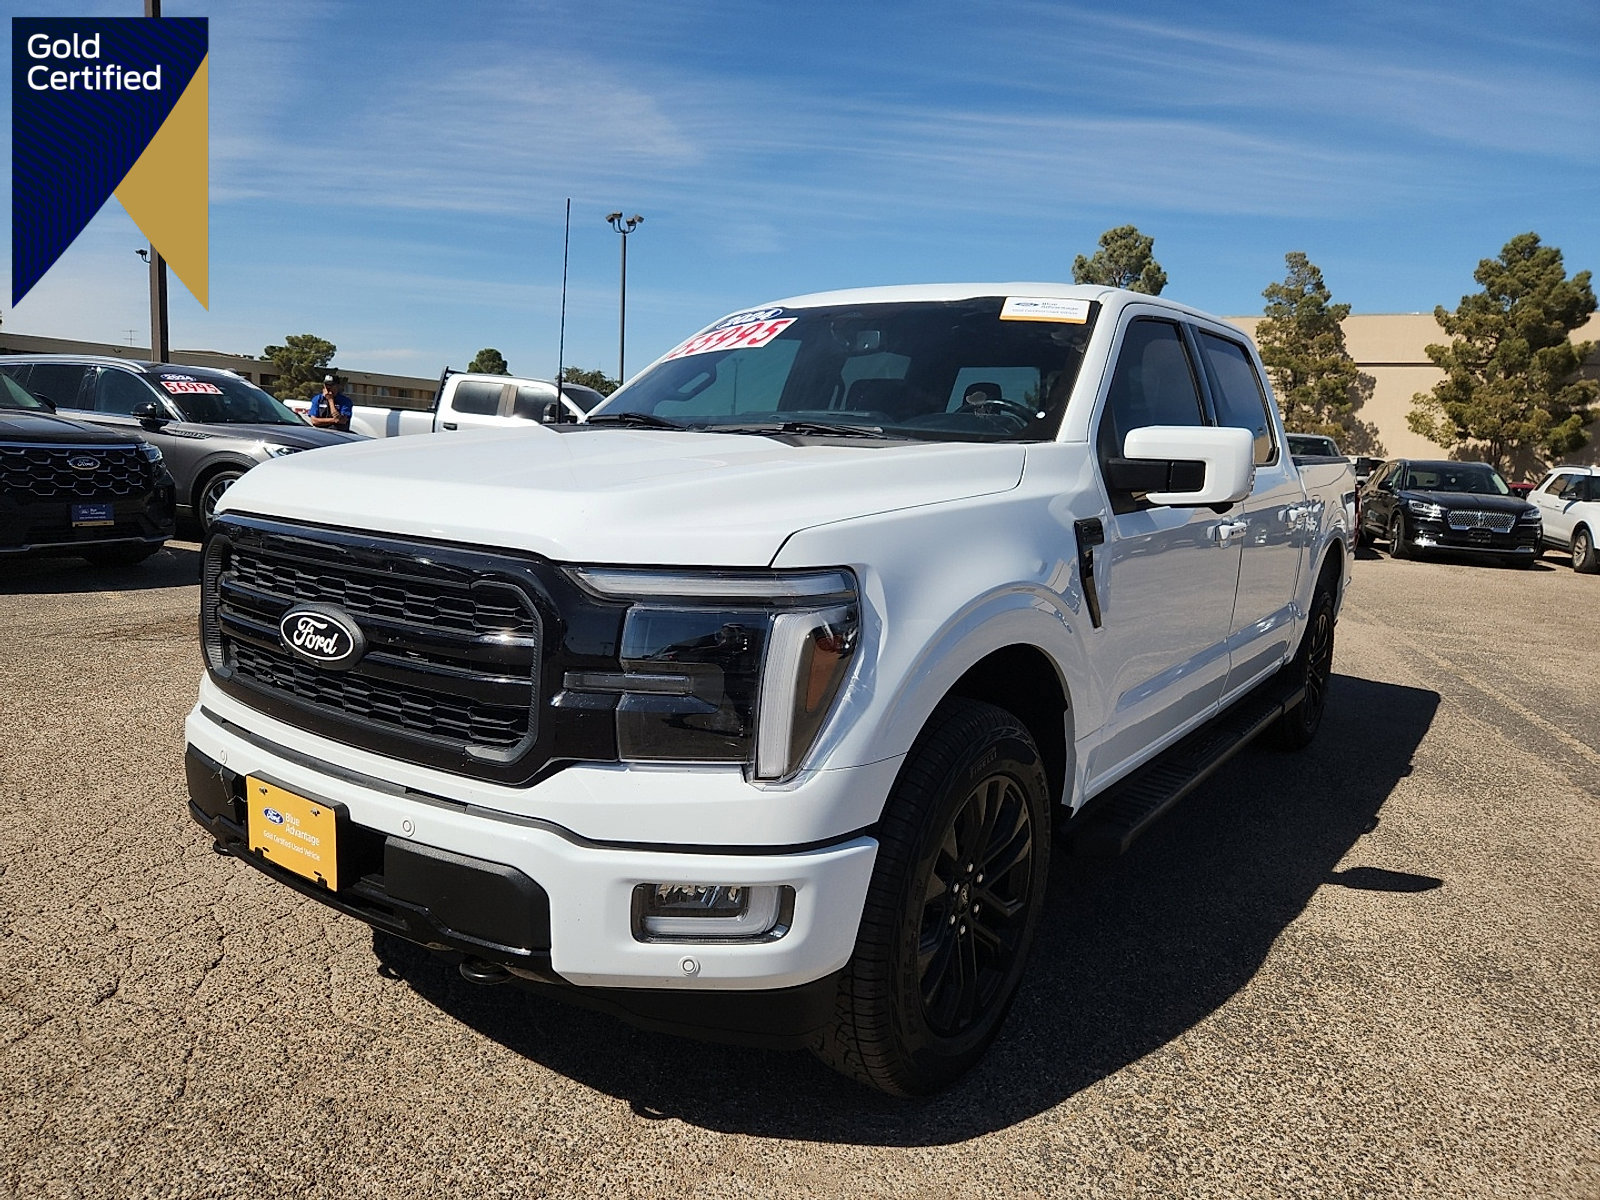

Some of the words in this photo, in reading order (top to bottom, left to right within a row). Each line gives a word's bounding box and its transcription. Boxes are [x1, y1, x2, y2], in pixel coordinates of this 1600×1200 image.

[164, 382, 218, 393] 56995
[77, 458, 95, 467] Ford
[293, 616, 339, 655] Ford
[285, 812, 300, 827] Blue
[285, 824, 320, 846] Advantage
[273, 834, 292, 849] Certified
[291, 843, 304, 854] Used
